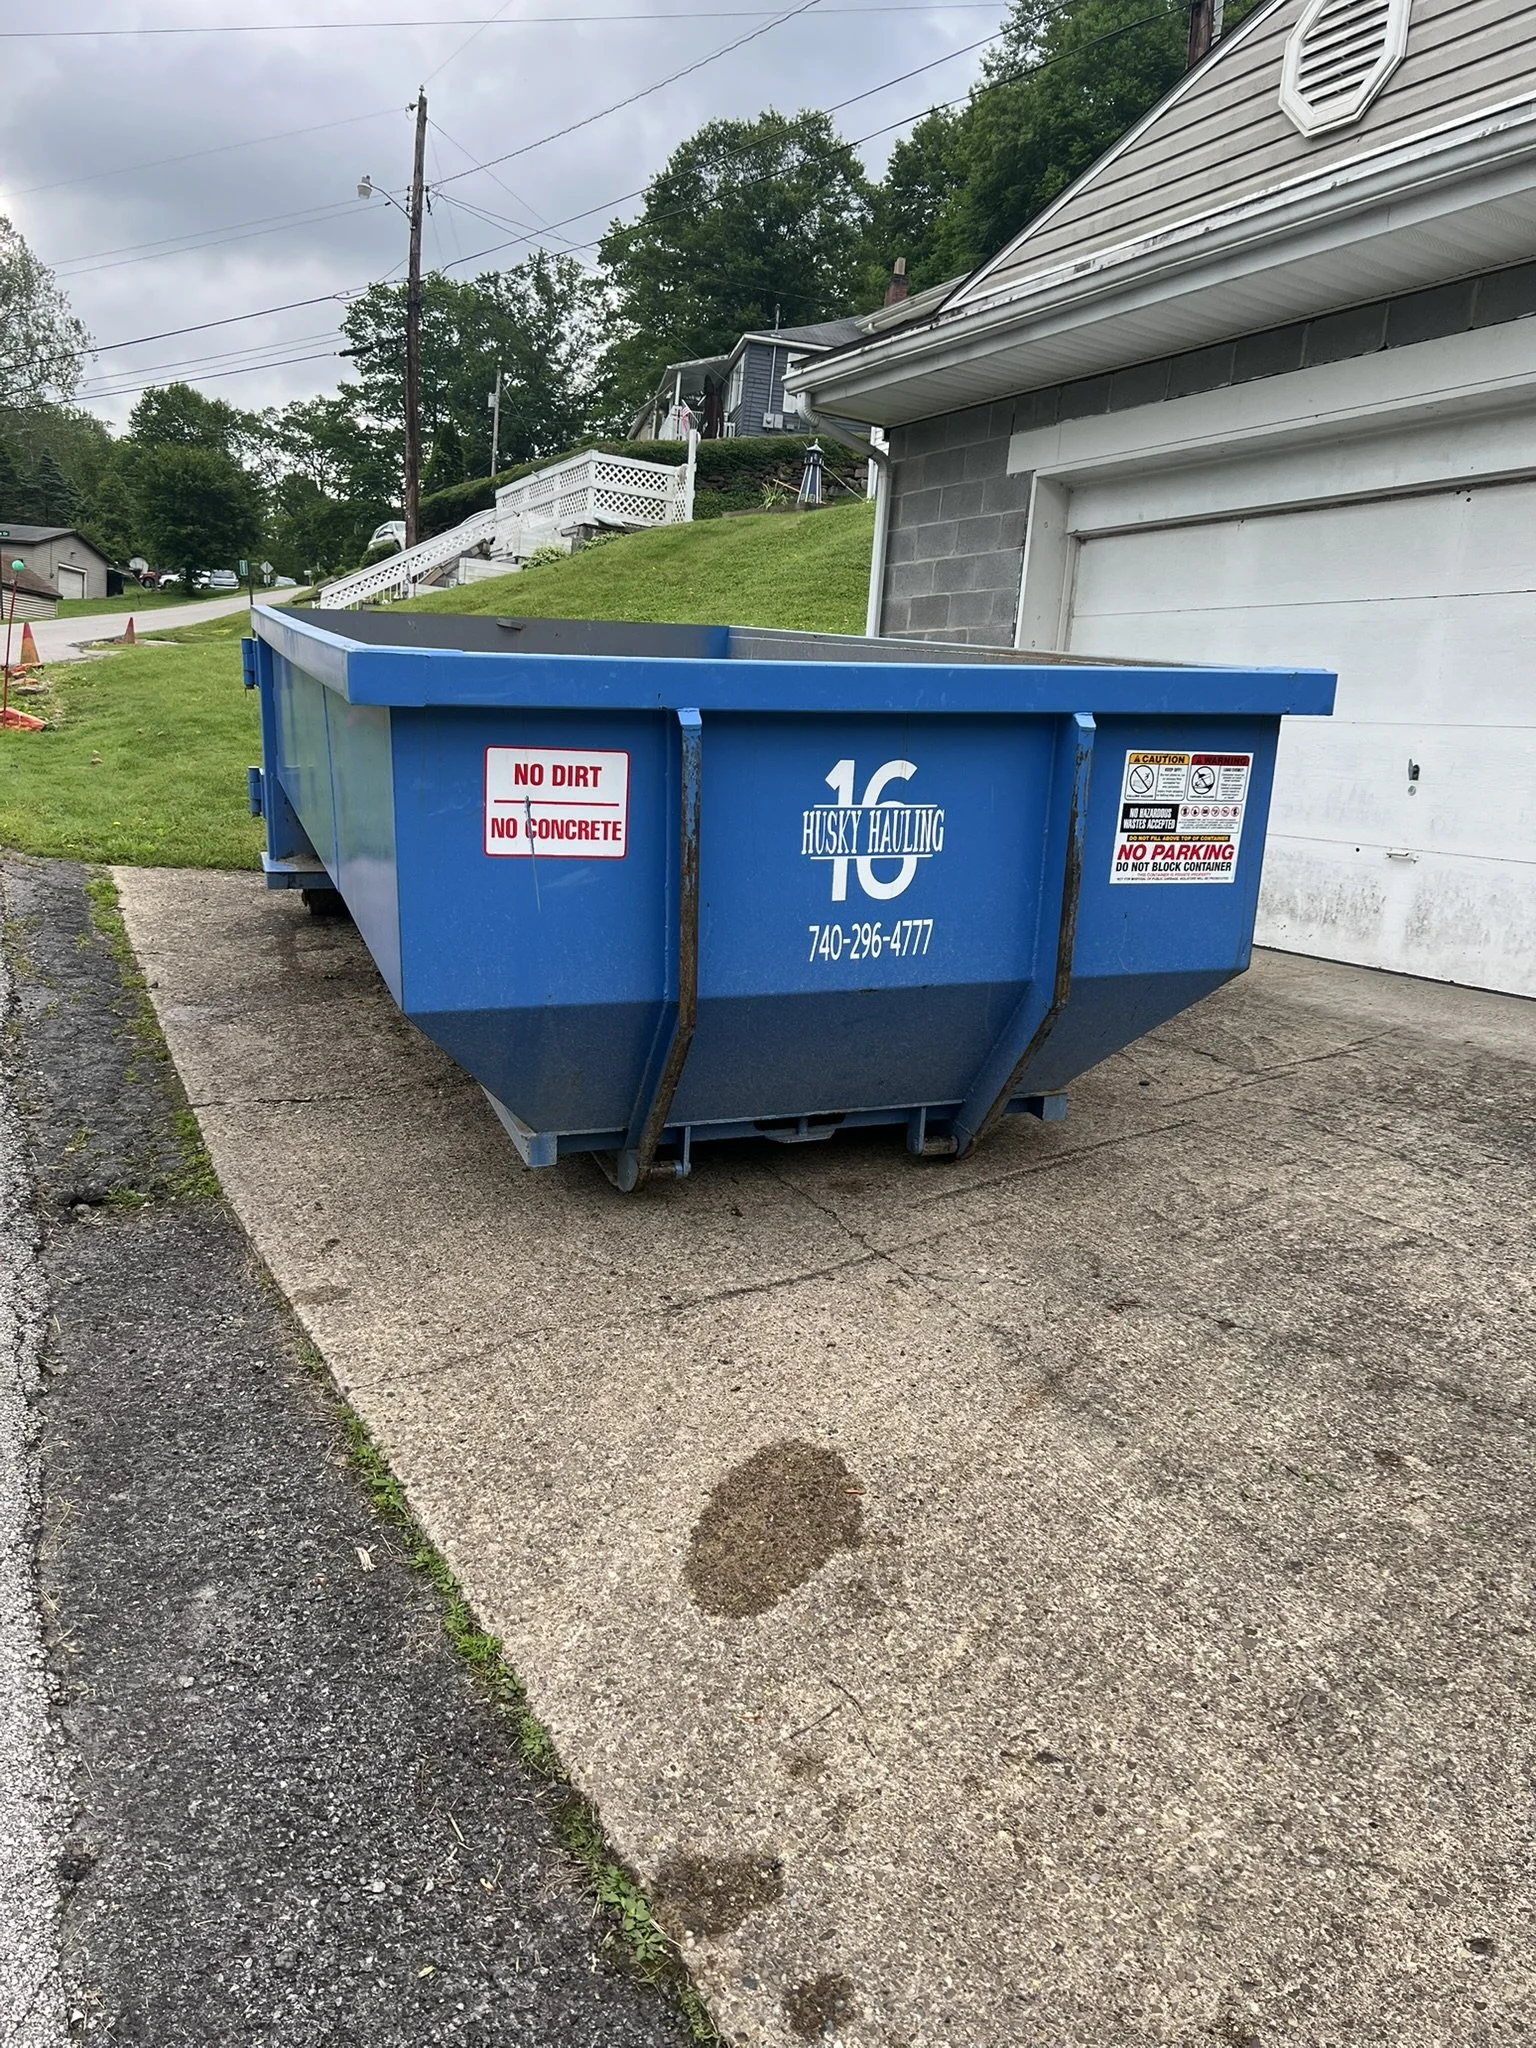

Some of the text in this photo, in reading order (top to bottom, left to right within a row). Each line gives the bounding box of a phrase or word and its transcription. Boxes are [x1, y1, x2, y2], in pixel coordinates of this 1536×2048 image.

[1206, 756, 1246, 765] WARNING
[514, 763, 602, 788] NO DIRT
[1129, 808, 1172, 818] NO HAZARDOUS
[491, 818, 622, 840] NO CONCRETE
[801, 809, 945, 854] HUSKY HAULING
[1123, 819, 1146, 829] WASTES
[1147, 819, 1175, 829] ACCEPTED
[1117, 845, 1234, 860] NO PARKING
[1116, 862, 1231, 871] DO NOT BLOCK CONTAINER
[809, 919, 933, 962] 740-296-4777
